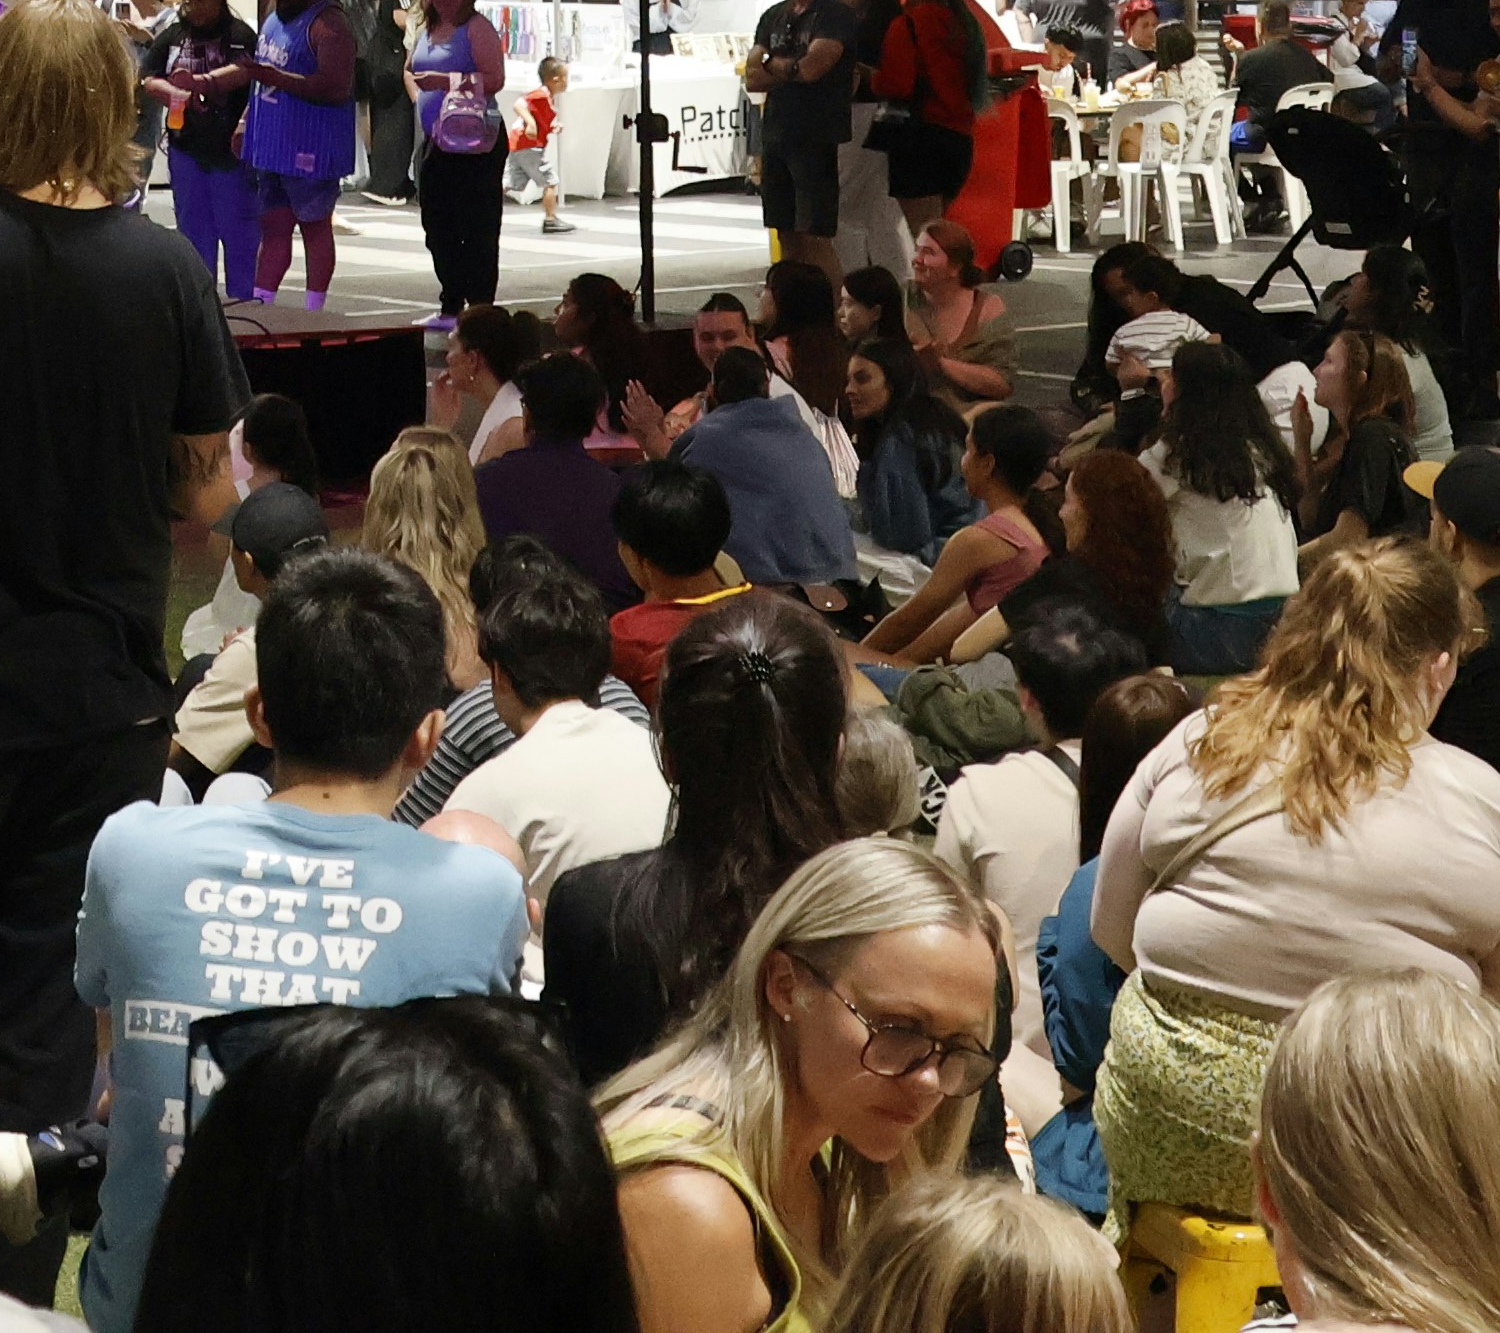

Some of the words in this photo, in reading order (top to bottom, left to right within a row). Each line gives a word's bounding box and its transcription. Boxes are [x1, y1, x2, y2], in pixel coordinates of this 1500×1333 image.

[241, 850, 355, 889] I'VE
[184, 878, 308, 924] GOT
[321, 894, 404, 934] TO
[199, 919, 378, 973] SHOW
[204, 962, 361, 1007] THAT
[127, 1006, 190, 1037] BEA
